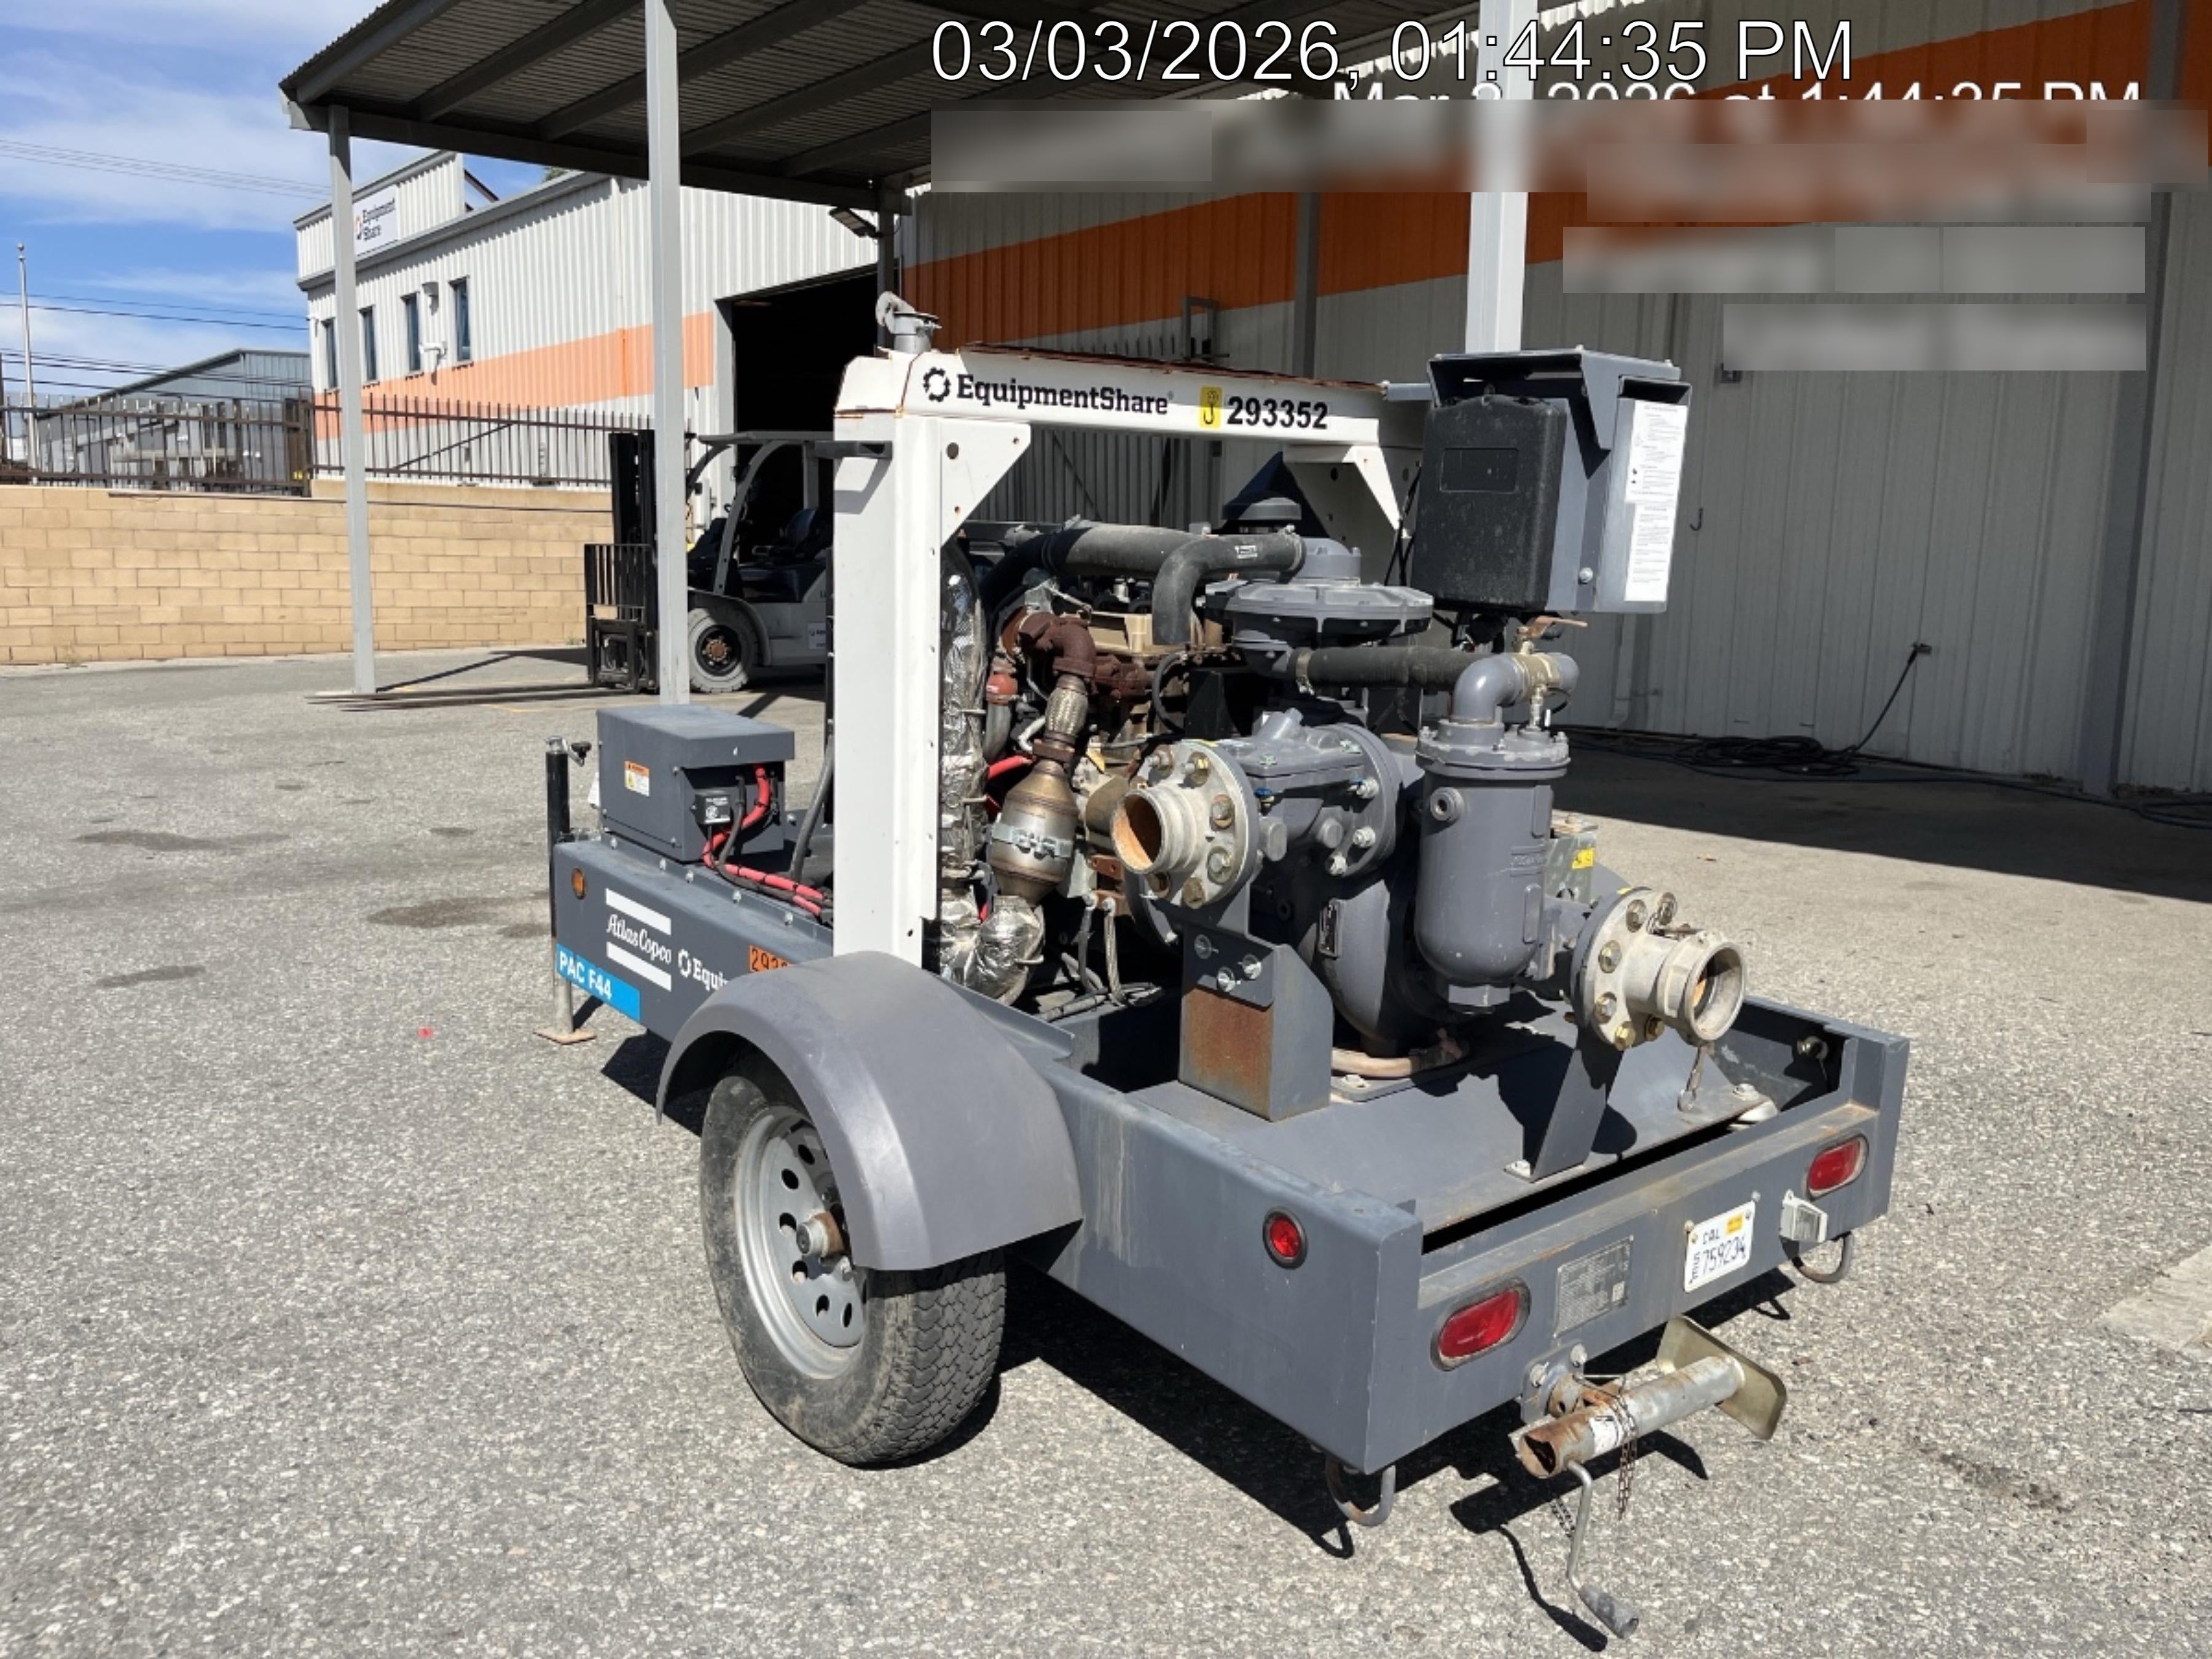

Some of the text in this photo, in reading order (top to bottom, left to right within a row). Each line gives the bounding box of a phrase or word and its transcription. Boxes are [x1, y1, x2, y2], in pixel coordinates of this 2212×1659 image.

[957, 374, 1328, 429] EquipmentShare 293352
[560, 950, 586, 983] PAC
